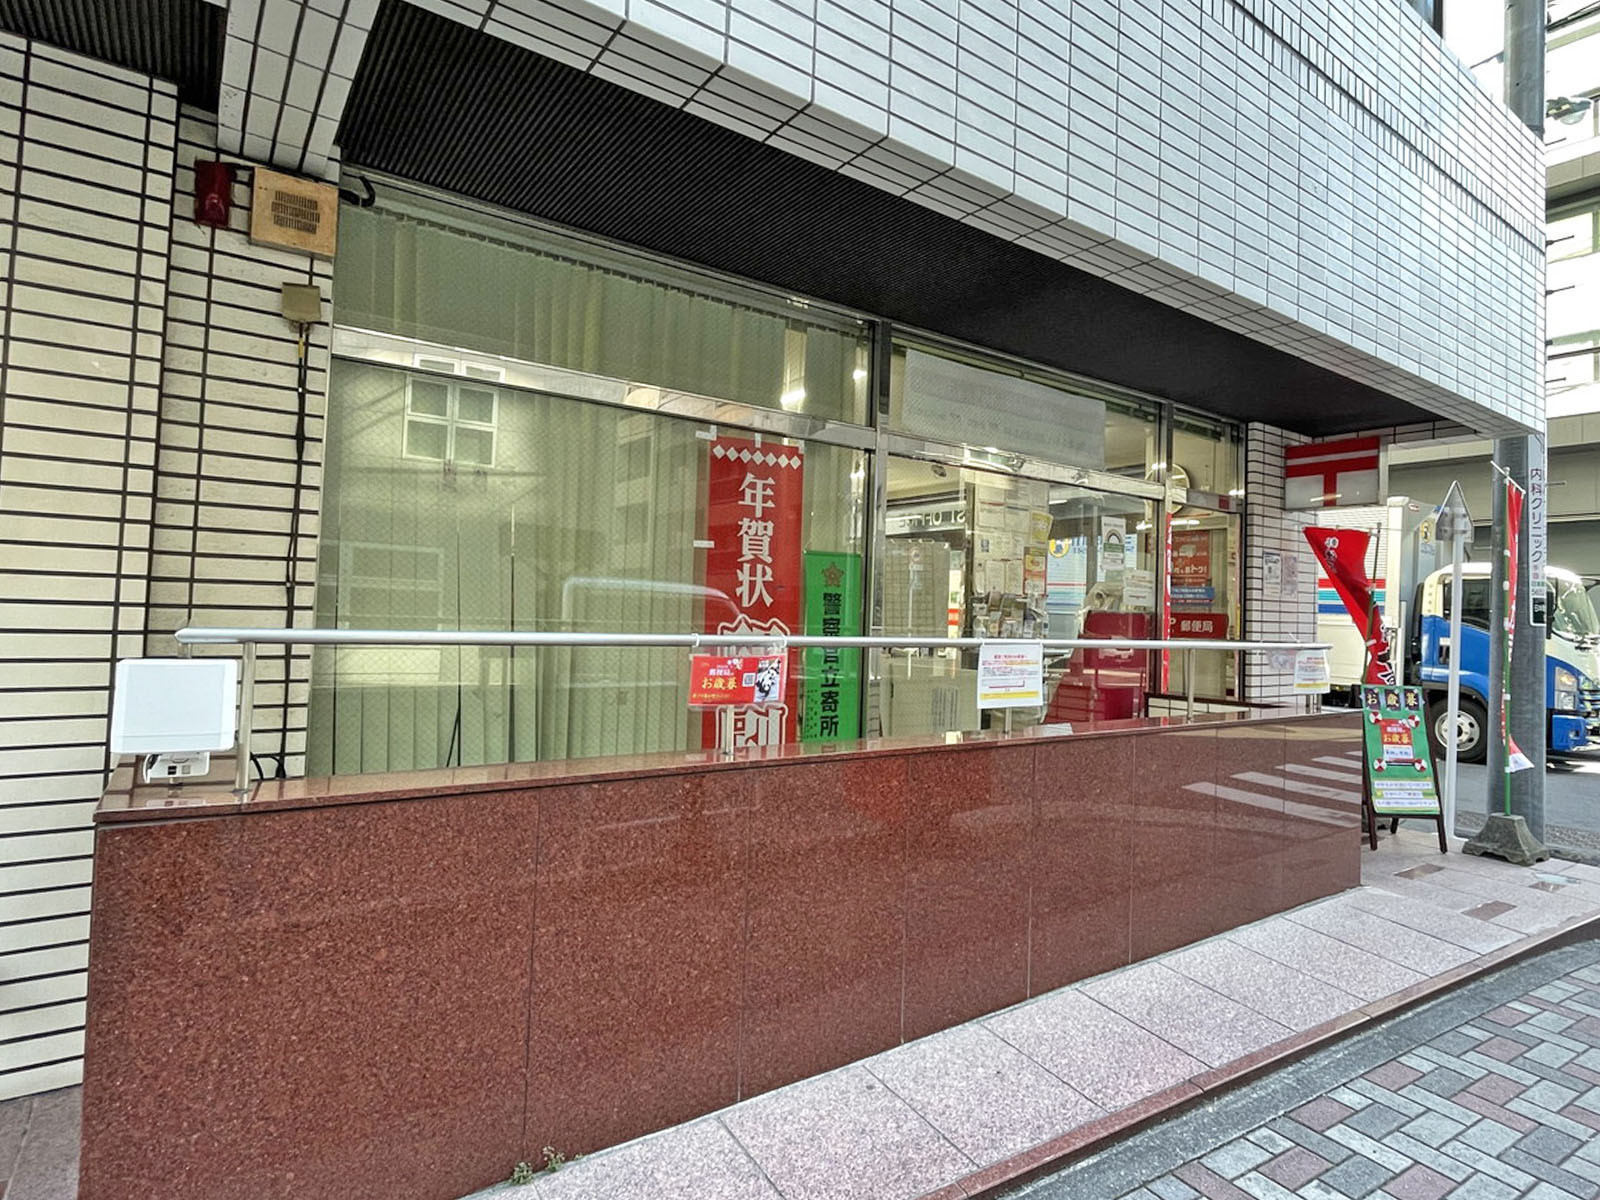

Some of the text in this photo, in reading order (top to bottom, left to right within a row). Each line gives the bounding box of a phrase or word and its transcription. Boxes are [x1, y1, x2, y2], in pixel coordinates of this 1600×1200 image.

[736, 473, 775, 607] 年賀状
[1531, 468, 1542, 563] 内科クリニック
[820, 591, 841, 737] 警察官立寄所
[1180, 619, 1213, 633] 郵便局
[702, 677, 737, 690] お歳暮
